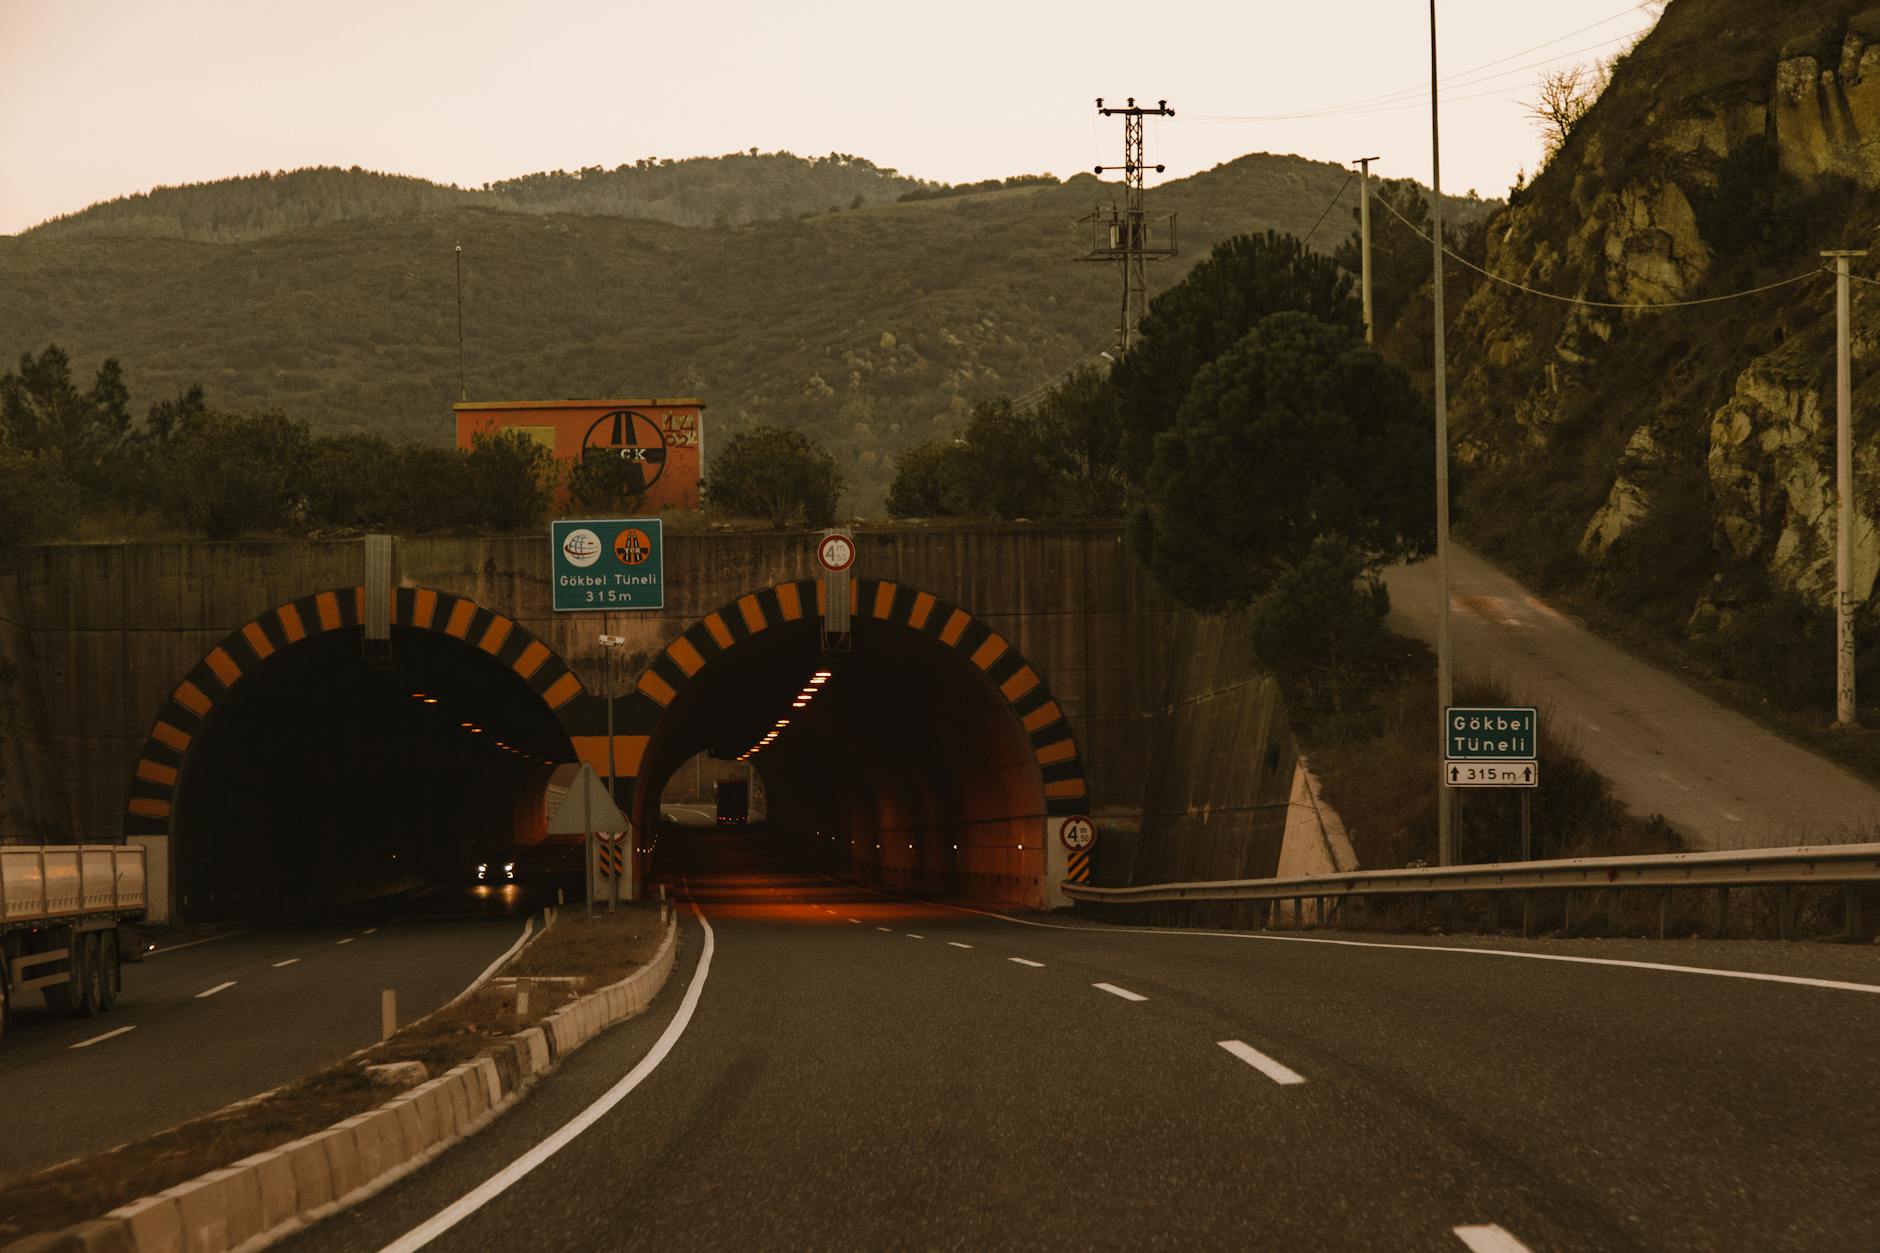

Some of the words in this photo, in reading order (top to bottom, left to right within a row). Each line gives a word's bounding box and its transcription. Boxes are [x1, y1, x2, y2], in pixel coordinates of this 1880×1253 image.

[825, 545, 835, 561] 4
[560, 575, 607, 586] Gökbel
[614, 574, 657, 586] Tüneli
[1454, 716, 1529, 731] Gökbel
[1454, 737, 1525, 752] Tüneli
[1467, 768, 1497, 780] 315
[1502, 771, 1516, 780] m
[1067, 826, 1077, 842] 4
